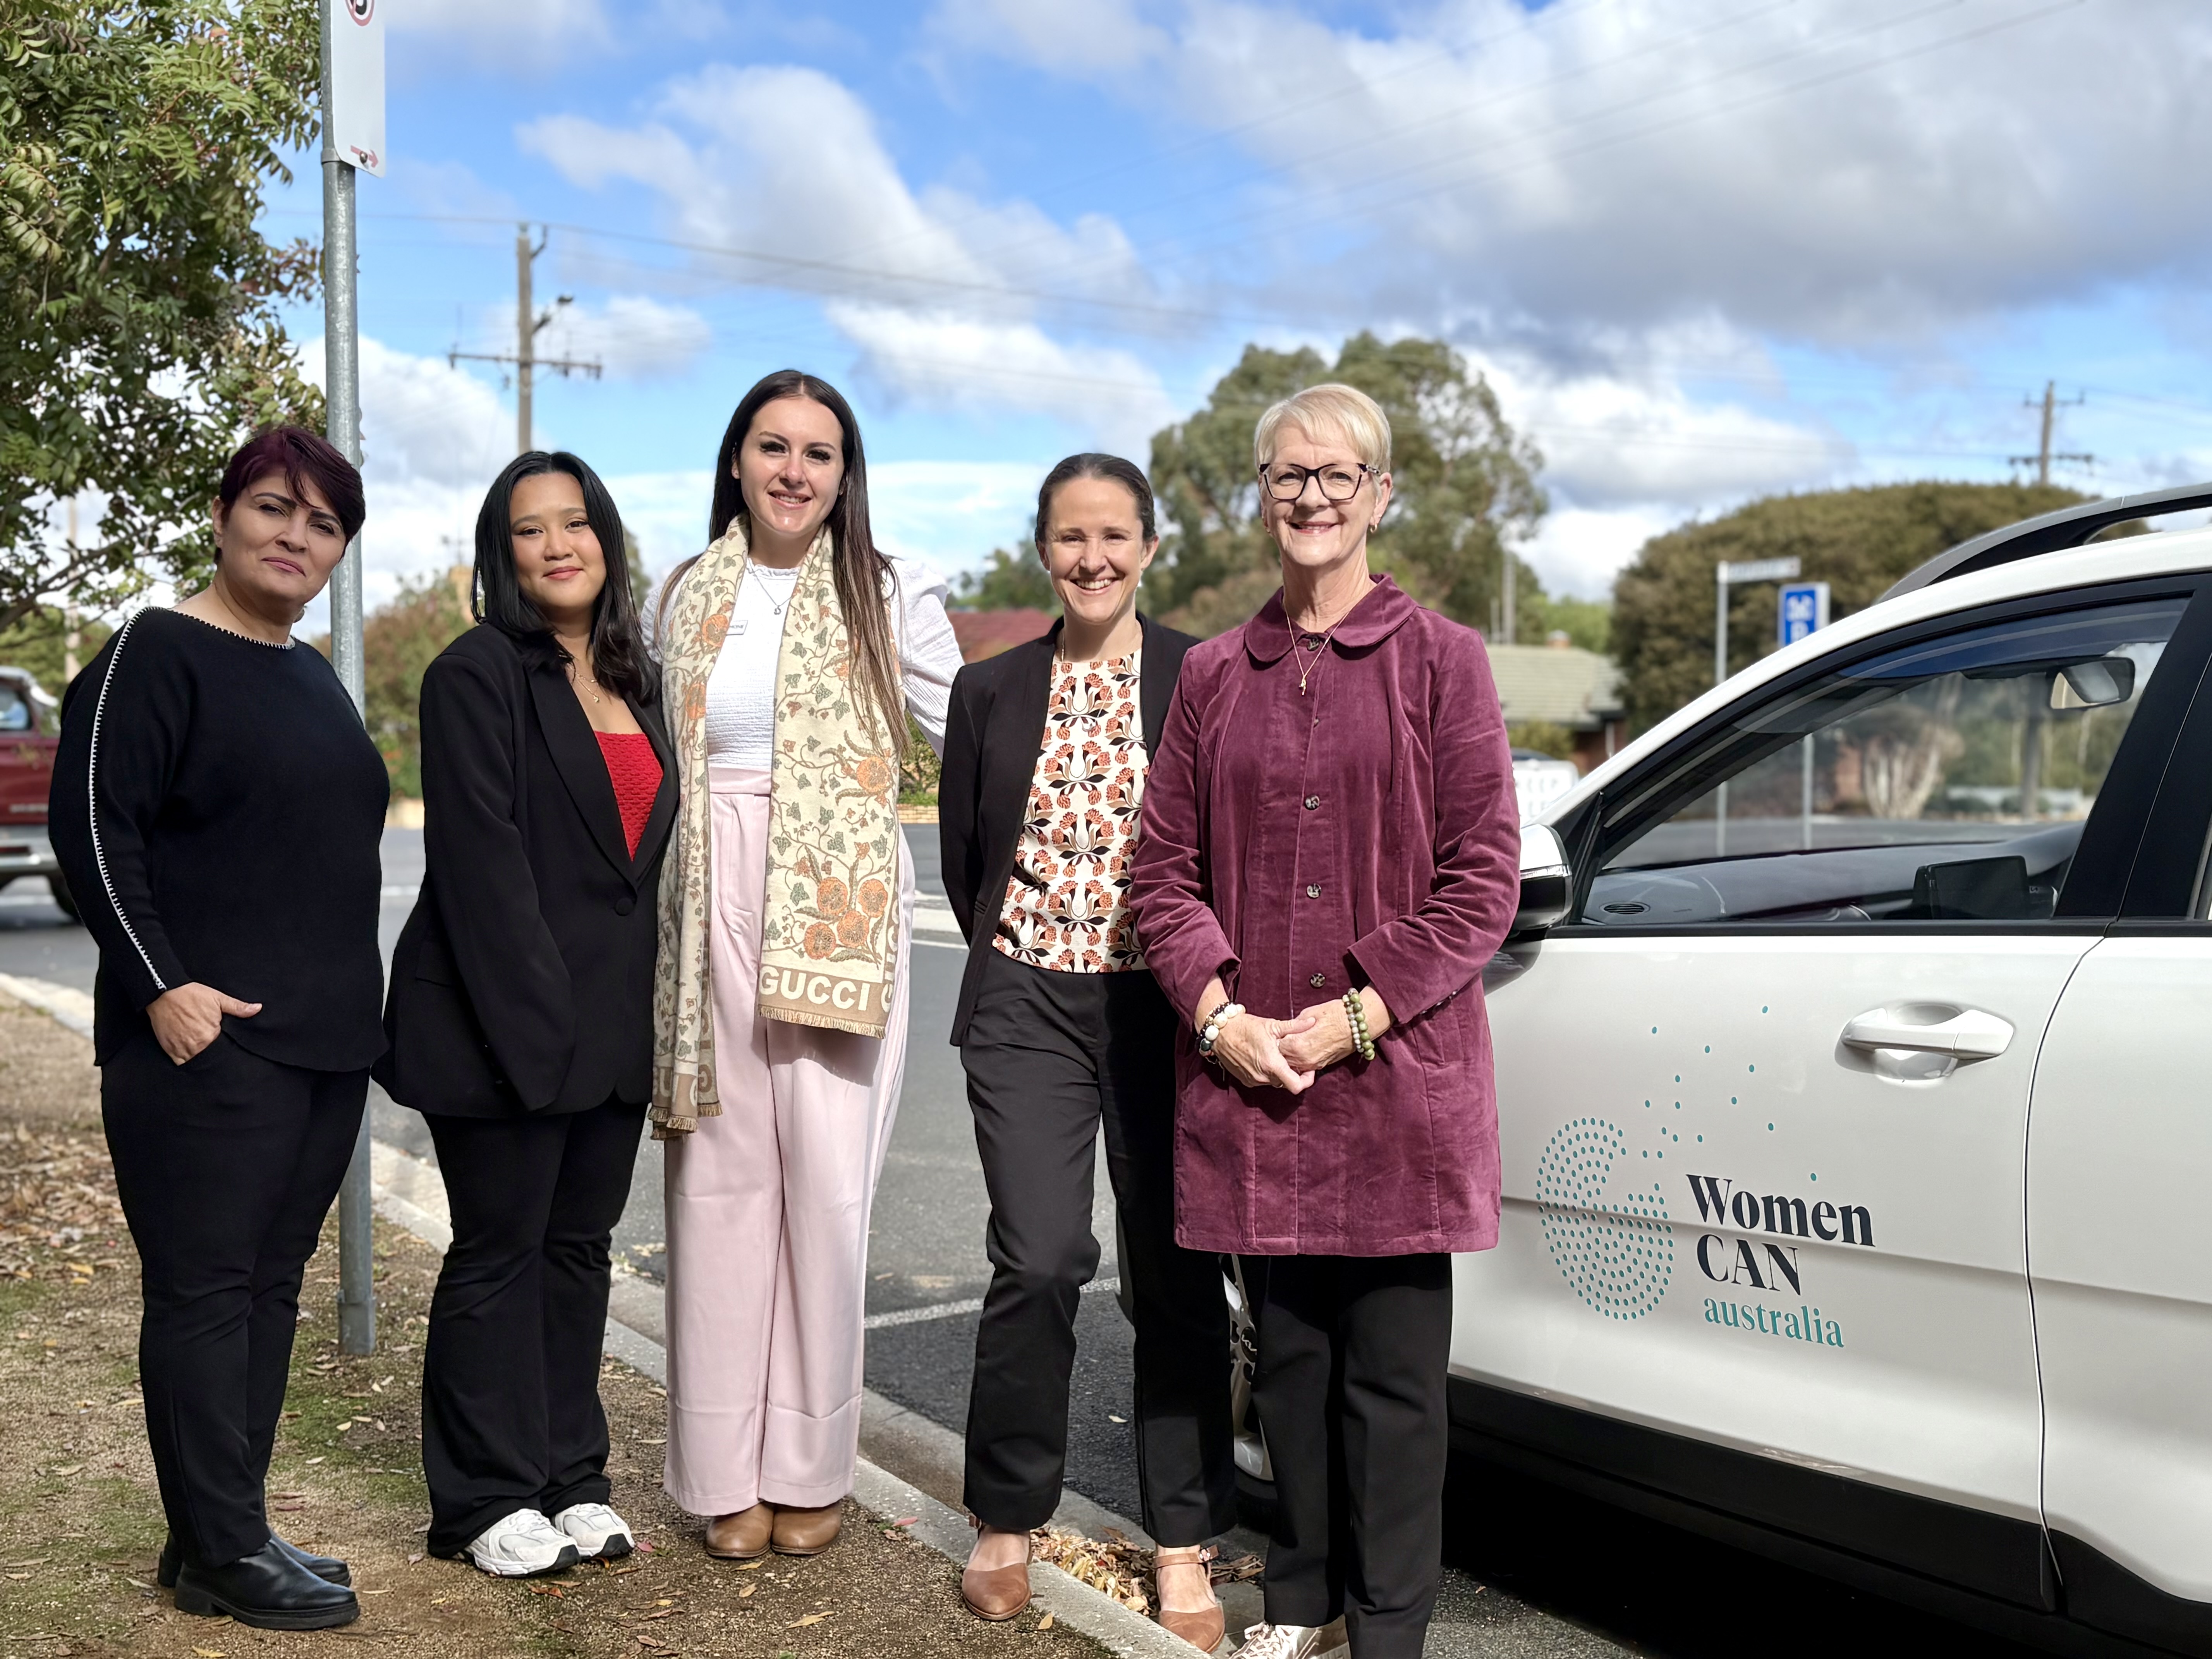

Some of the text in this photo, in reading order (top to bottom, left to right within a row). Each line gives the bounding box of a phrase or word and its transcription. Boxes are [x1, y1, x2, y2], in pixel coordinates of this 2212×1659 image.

[759, 965, 871, 1011] GUCCI
[1685, 1174, 1876, 1247] Women
[1697, 1234, 1801, 1295] CAN
[1704, 1297, 1844, 1348] australia
